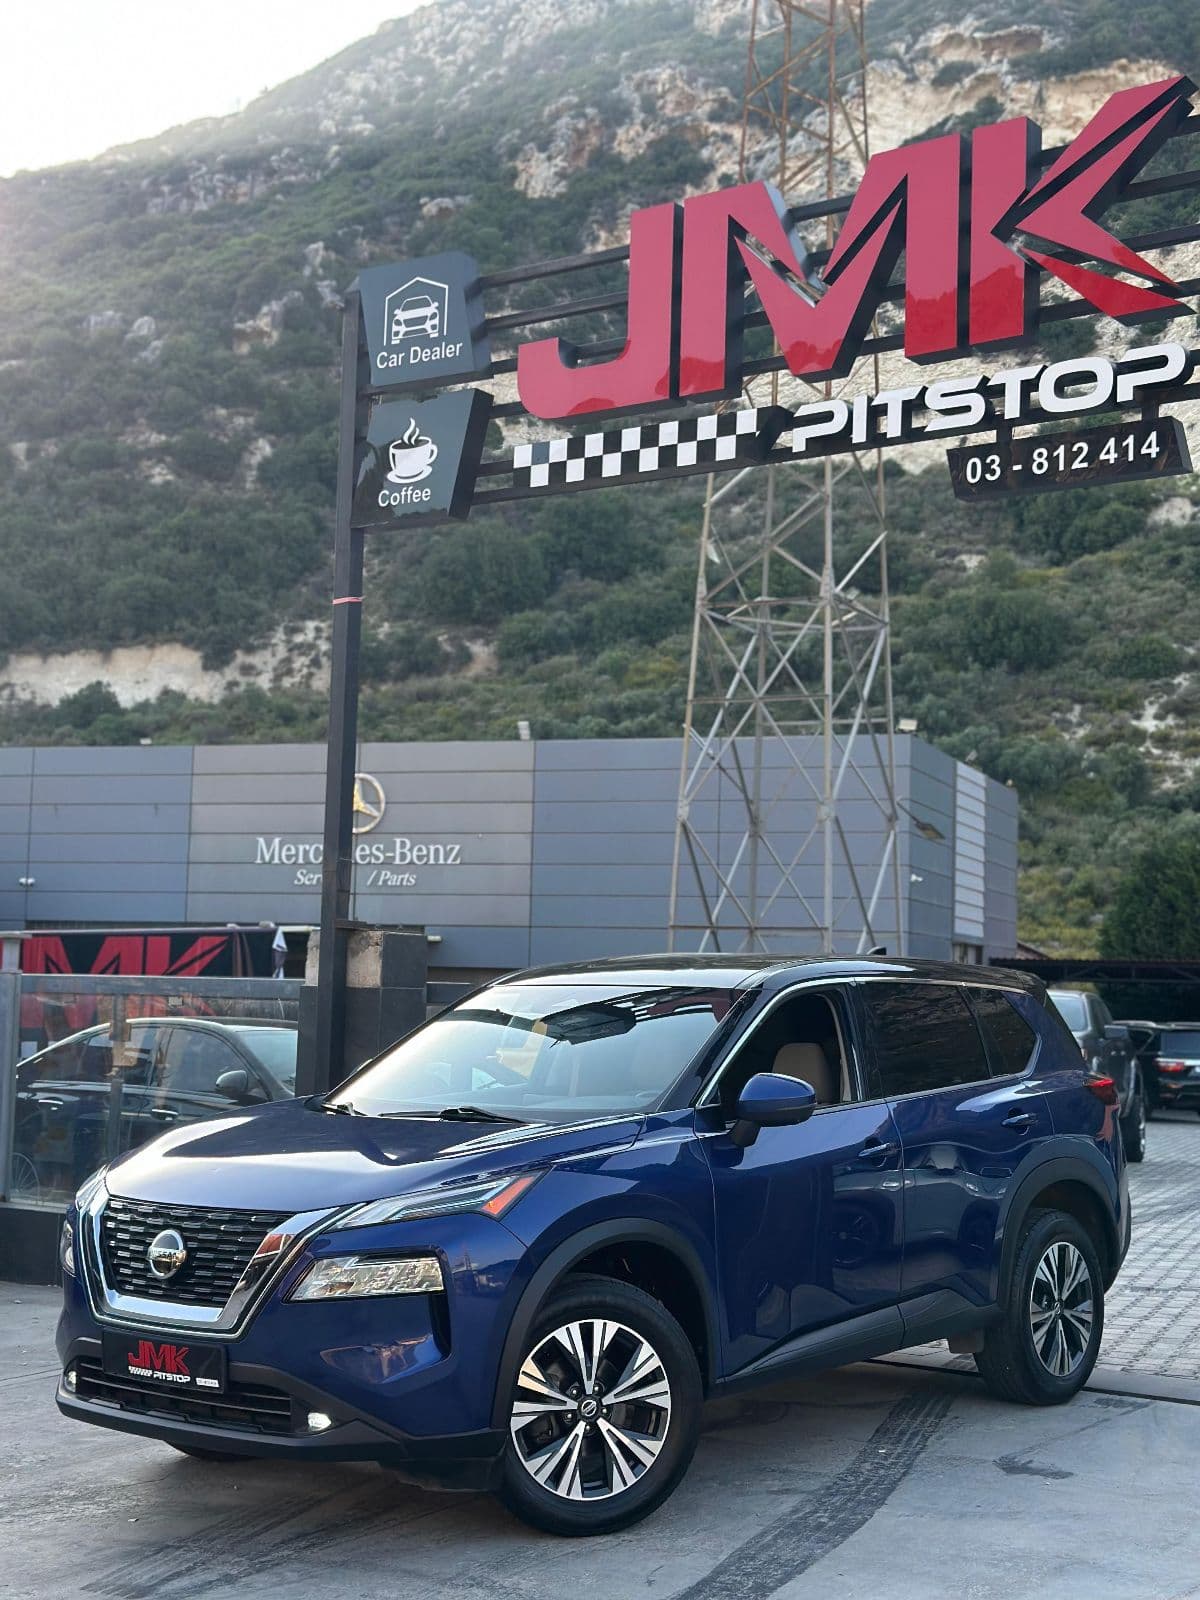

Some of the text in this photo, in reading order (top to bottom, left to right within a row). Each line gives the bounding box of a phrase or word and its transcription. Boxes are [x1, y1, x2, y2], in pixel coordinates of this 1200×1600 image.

[518, 75, 1192, 419] JMK
[377, 341, 463, 369] Car Dealer
[792, 342, 1186, 452] PITSTOP
[966, 457, 1001, 484] 03
[1032, 442, 1089, 475] 812
[1100, 431, 1160, 464] 414
[378, 488, 431, 507] Coffee
[255, 837, 461, 865] Merces-Benz
[378, 870, 416, 886] Parts
[128, 1340, 190, 1375] JMK
[153, 1371, 191, 1383] PITSTOP
